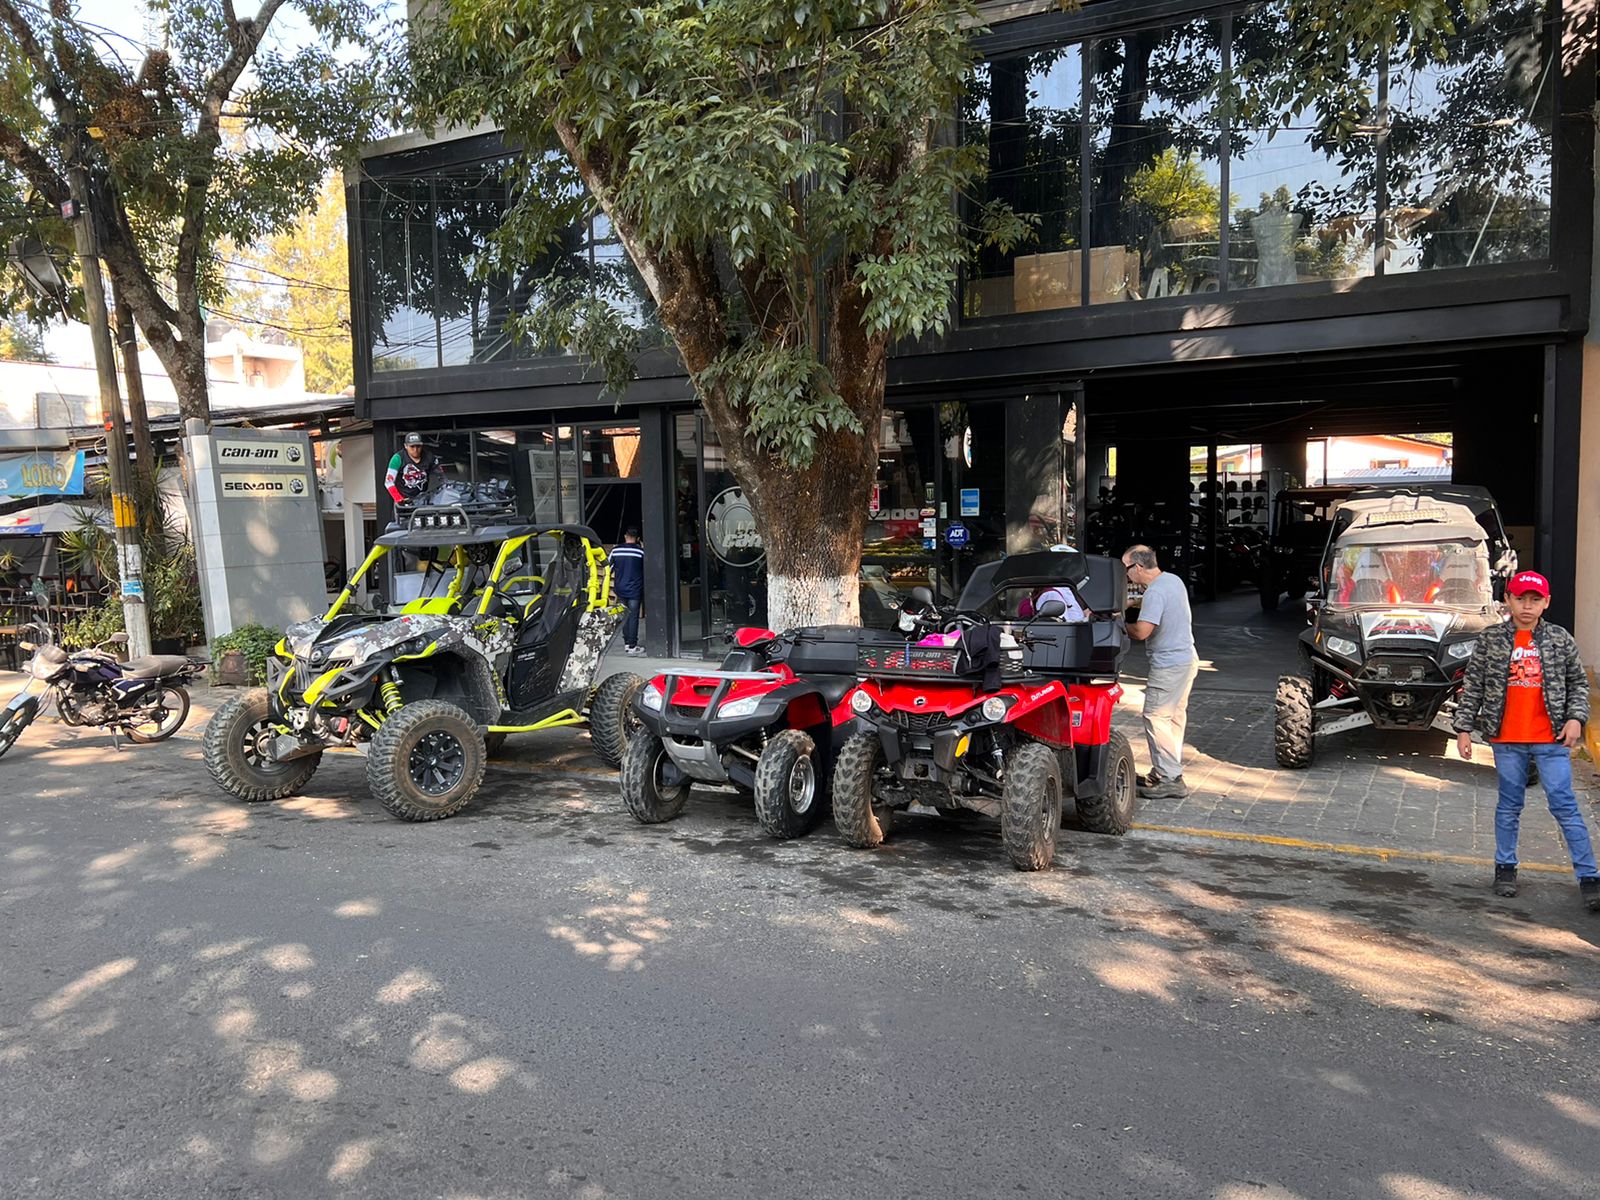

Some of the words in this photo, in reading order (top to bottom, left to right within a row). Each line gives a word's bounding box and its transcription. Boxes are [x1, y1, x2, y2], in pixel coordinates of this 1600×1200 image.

[221, 447, 279, 459] can-am
[949, 528, 965, 538] ADT
[1519, 575, 1543, 586] Jeep
